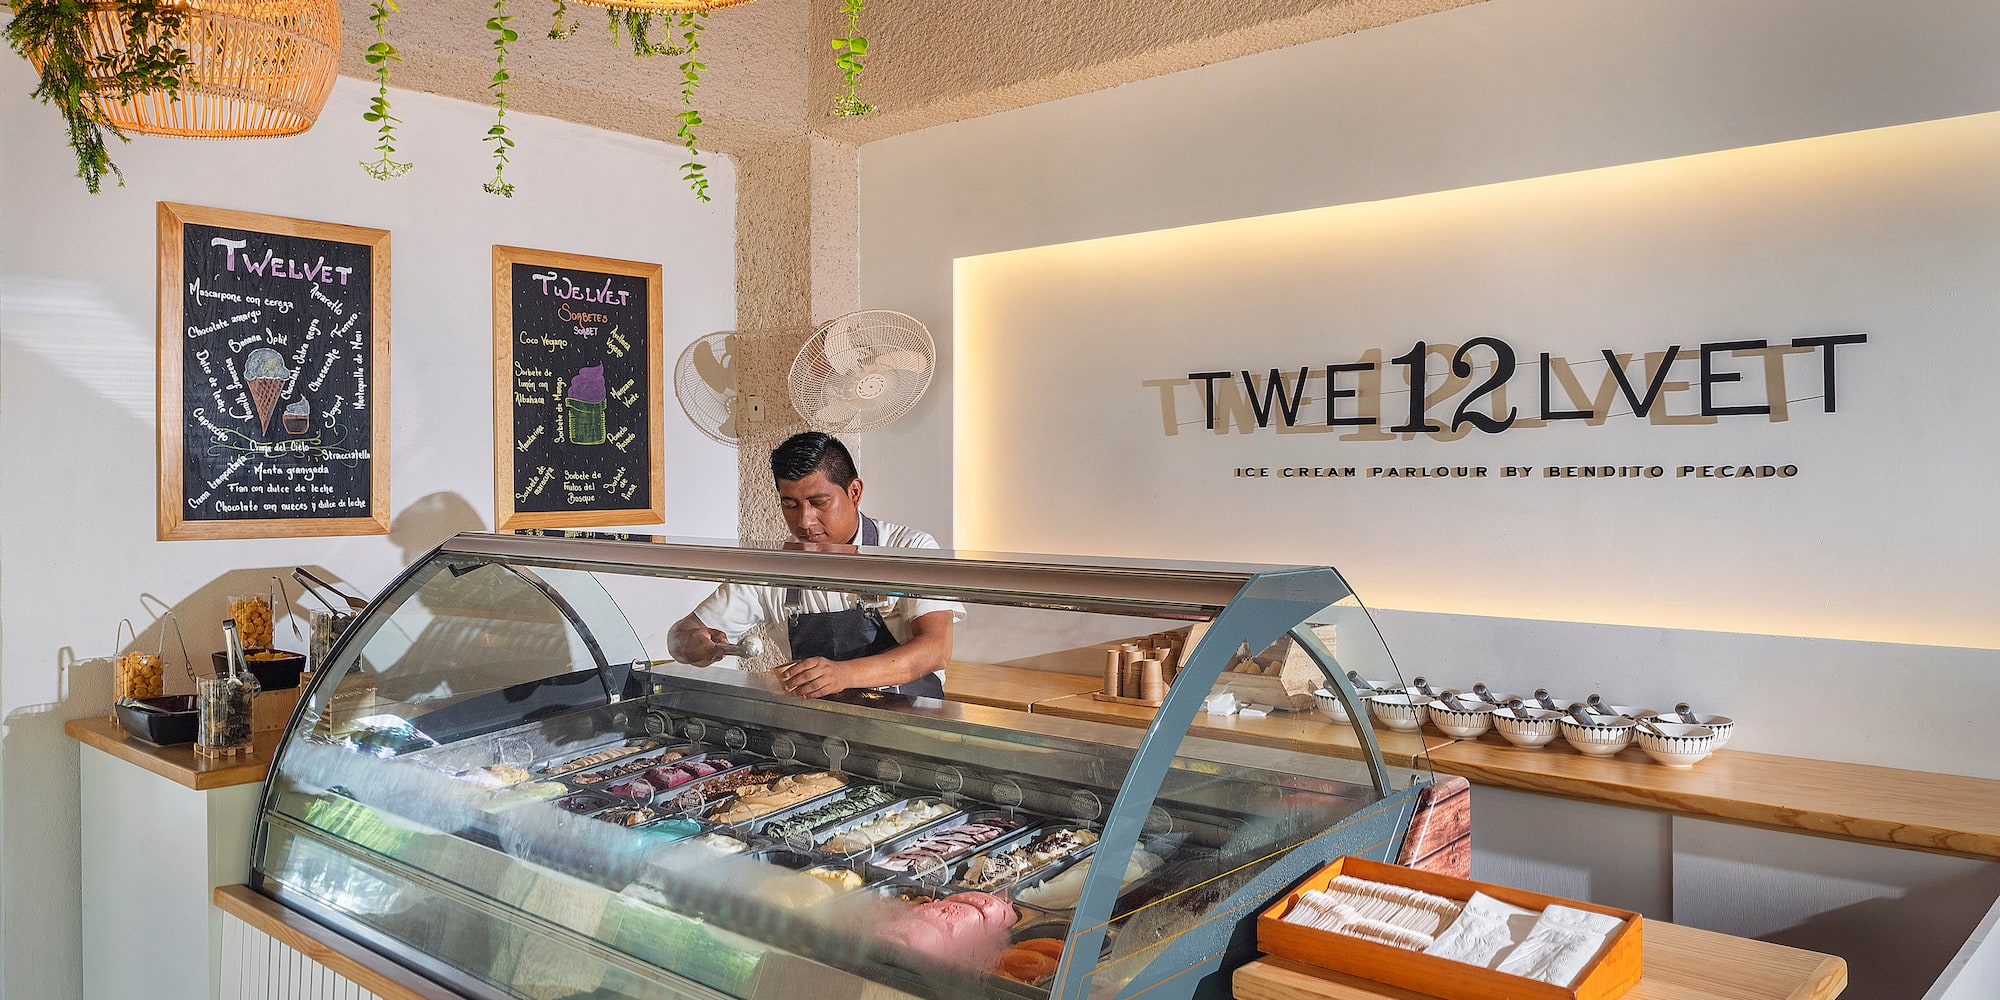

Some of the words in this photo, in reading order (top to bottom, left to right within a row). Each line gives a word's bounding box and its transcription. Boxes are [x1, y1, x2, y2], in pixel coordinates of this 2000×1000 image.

[189, 277, 242, 306] Mascarpone
[245, 296, 261, 307] con
[188, 319, 230, 338] Chocolate
[231, 310, 262, 324] amargo
[330, 313, 359, 338] Ferrero
[228, 335, 263, 353] Banana
[265, 327, 288, 346] Split
[520, 330, 539, 344] Coco
[540, 333, 568, 353] Vegano
[196, 349, 212, 375] Dulce
[281, 366, 301, 400] Chocolate
[306, 318, 322, 341] negra
[353, 353, 363, 364] de
[308, 348, 341, 392] Cheesecake
[514, 360, 542, 377] Sorbete
[544, 368, 552, 377] de
[208, 377, 218, 388] de
[538, 381, 549, 392] con
[552, 377, 567, 401] Mango
[212, 389, 226, 414] leche
[514, 391, 545, 407] Albahaca
[555, 403, 564, 413] de
[322, 394, 345, 429] Yogurt
[554, 414, 565, 443] Sorbete
[274, 442, 287, 452] del
[290, 441, 310, 452] Cielo
[322, 449, 370, 461] Stracciatella
[207, 455, 247, 489] tramontana
[254, 462, 283, 481] Menta
[286, 464, 329, 481] granizada
[564, 470, 590, 480] Sorbete
[591, 470, 602, 479] de
[603, 466, 627, 494] Sorbete
[1237, 467, 1269, 477] ICE
[1283, 467, 1356, 477] CREAM
[1373, 466, 1488, 477] PARLOUR
[1506, 466, 1534, 477] BY
[1550, 466, 1664, 477] BENDITO
[1683, 465, 1799, 477] PECADO
[251, 486, 264, 494] con
[266, 483, 290, 493] dulce
[294, 483, 306, 493] de
[311, 483, 334, 493] leche
[515, 476, 540, 503] Sorbete
[536, 465, 547, 475] de
[583, 482, 596, 491] del
[620, 478, 628, 489] de
[215, 500, 259, 512] Chocolate
[263, 504, 277, 513] con
[281, 503, 308, 512] nueces
[311, 503, 317, 512] y
[318, 500, 336, 509] dulce
[338, 499, 346, 508] de
[347, 497, 367, 508] leche
[567, 492, 596, 505] Bosque
